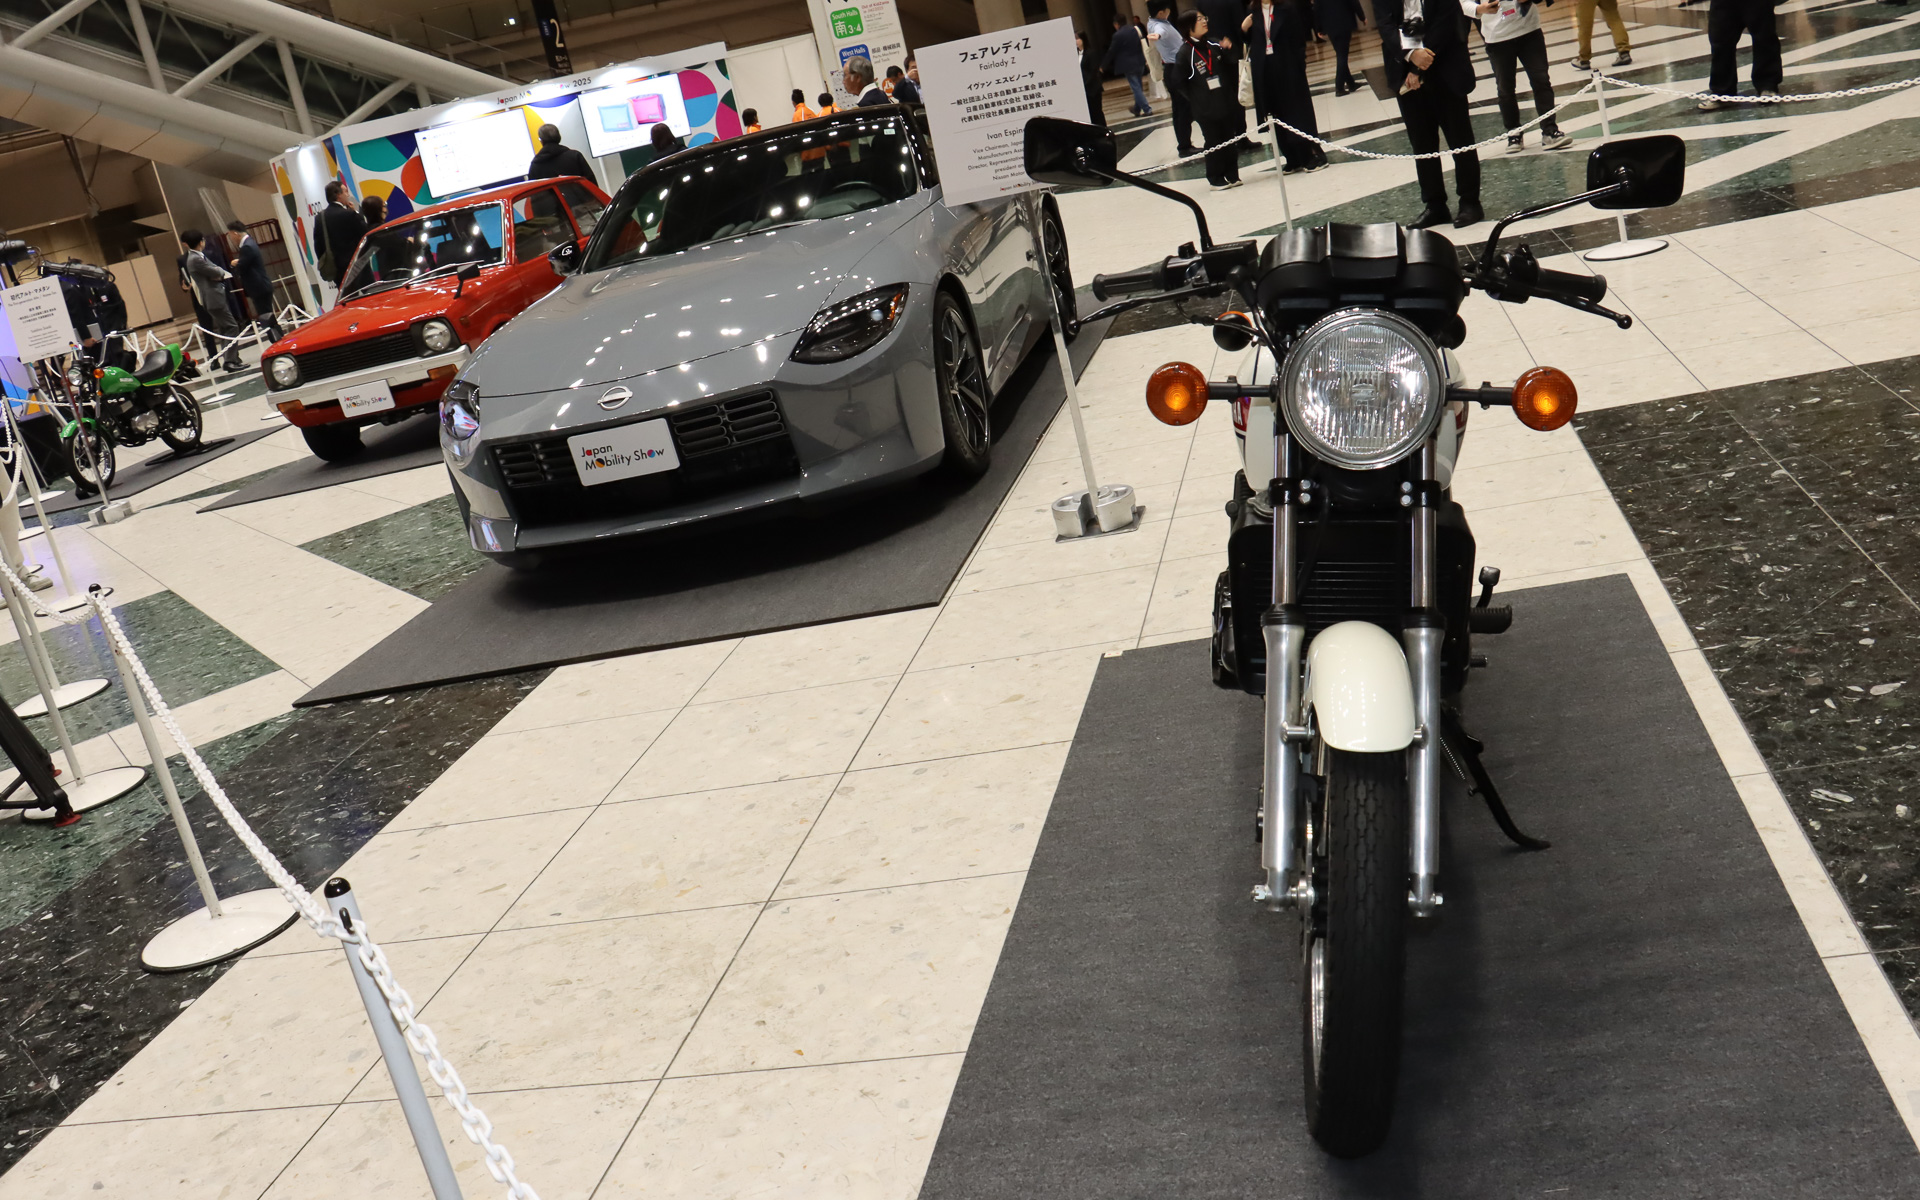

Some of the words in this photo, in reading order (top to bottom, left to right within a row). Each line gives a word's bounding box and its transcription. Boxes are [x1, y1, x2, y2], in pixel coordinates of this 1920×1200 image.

[832, 12, 847, 20] South
[847, 9, 859, 17] Halls
[834, 20, 847, 37] 南
[842, 49, 855, 57] West
[855, 46, 866, 54] Halls
[959, 37, 1031, 63] フェアレディZ
[979, 58, 1009, 71] Fairlady
[1011, 57, 1016, 65] Z
[1038, 79, 1058, 89] 副会長
[497, 95, 518, 105] Japan
[572, 77, 592, 88] 2025
[987, 132, 1003, 140] Ivan
[346, 400, 370, 409] Mobility
[371, 396, 387, 404] Show
[581, 445, 613, 458] Japan
[585, 454, 631, 471] Mobility
[633, 448, 665, 461] Show
